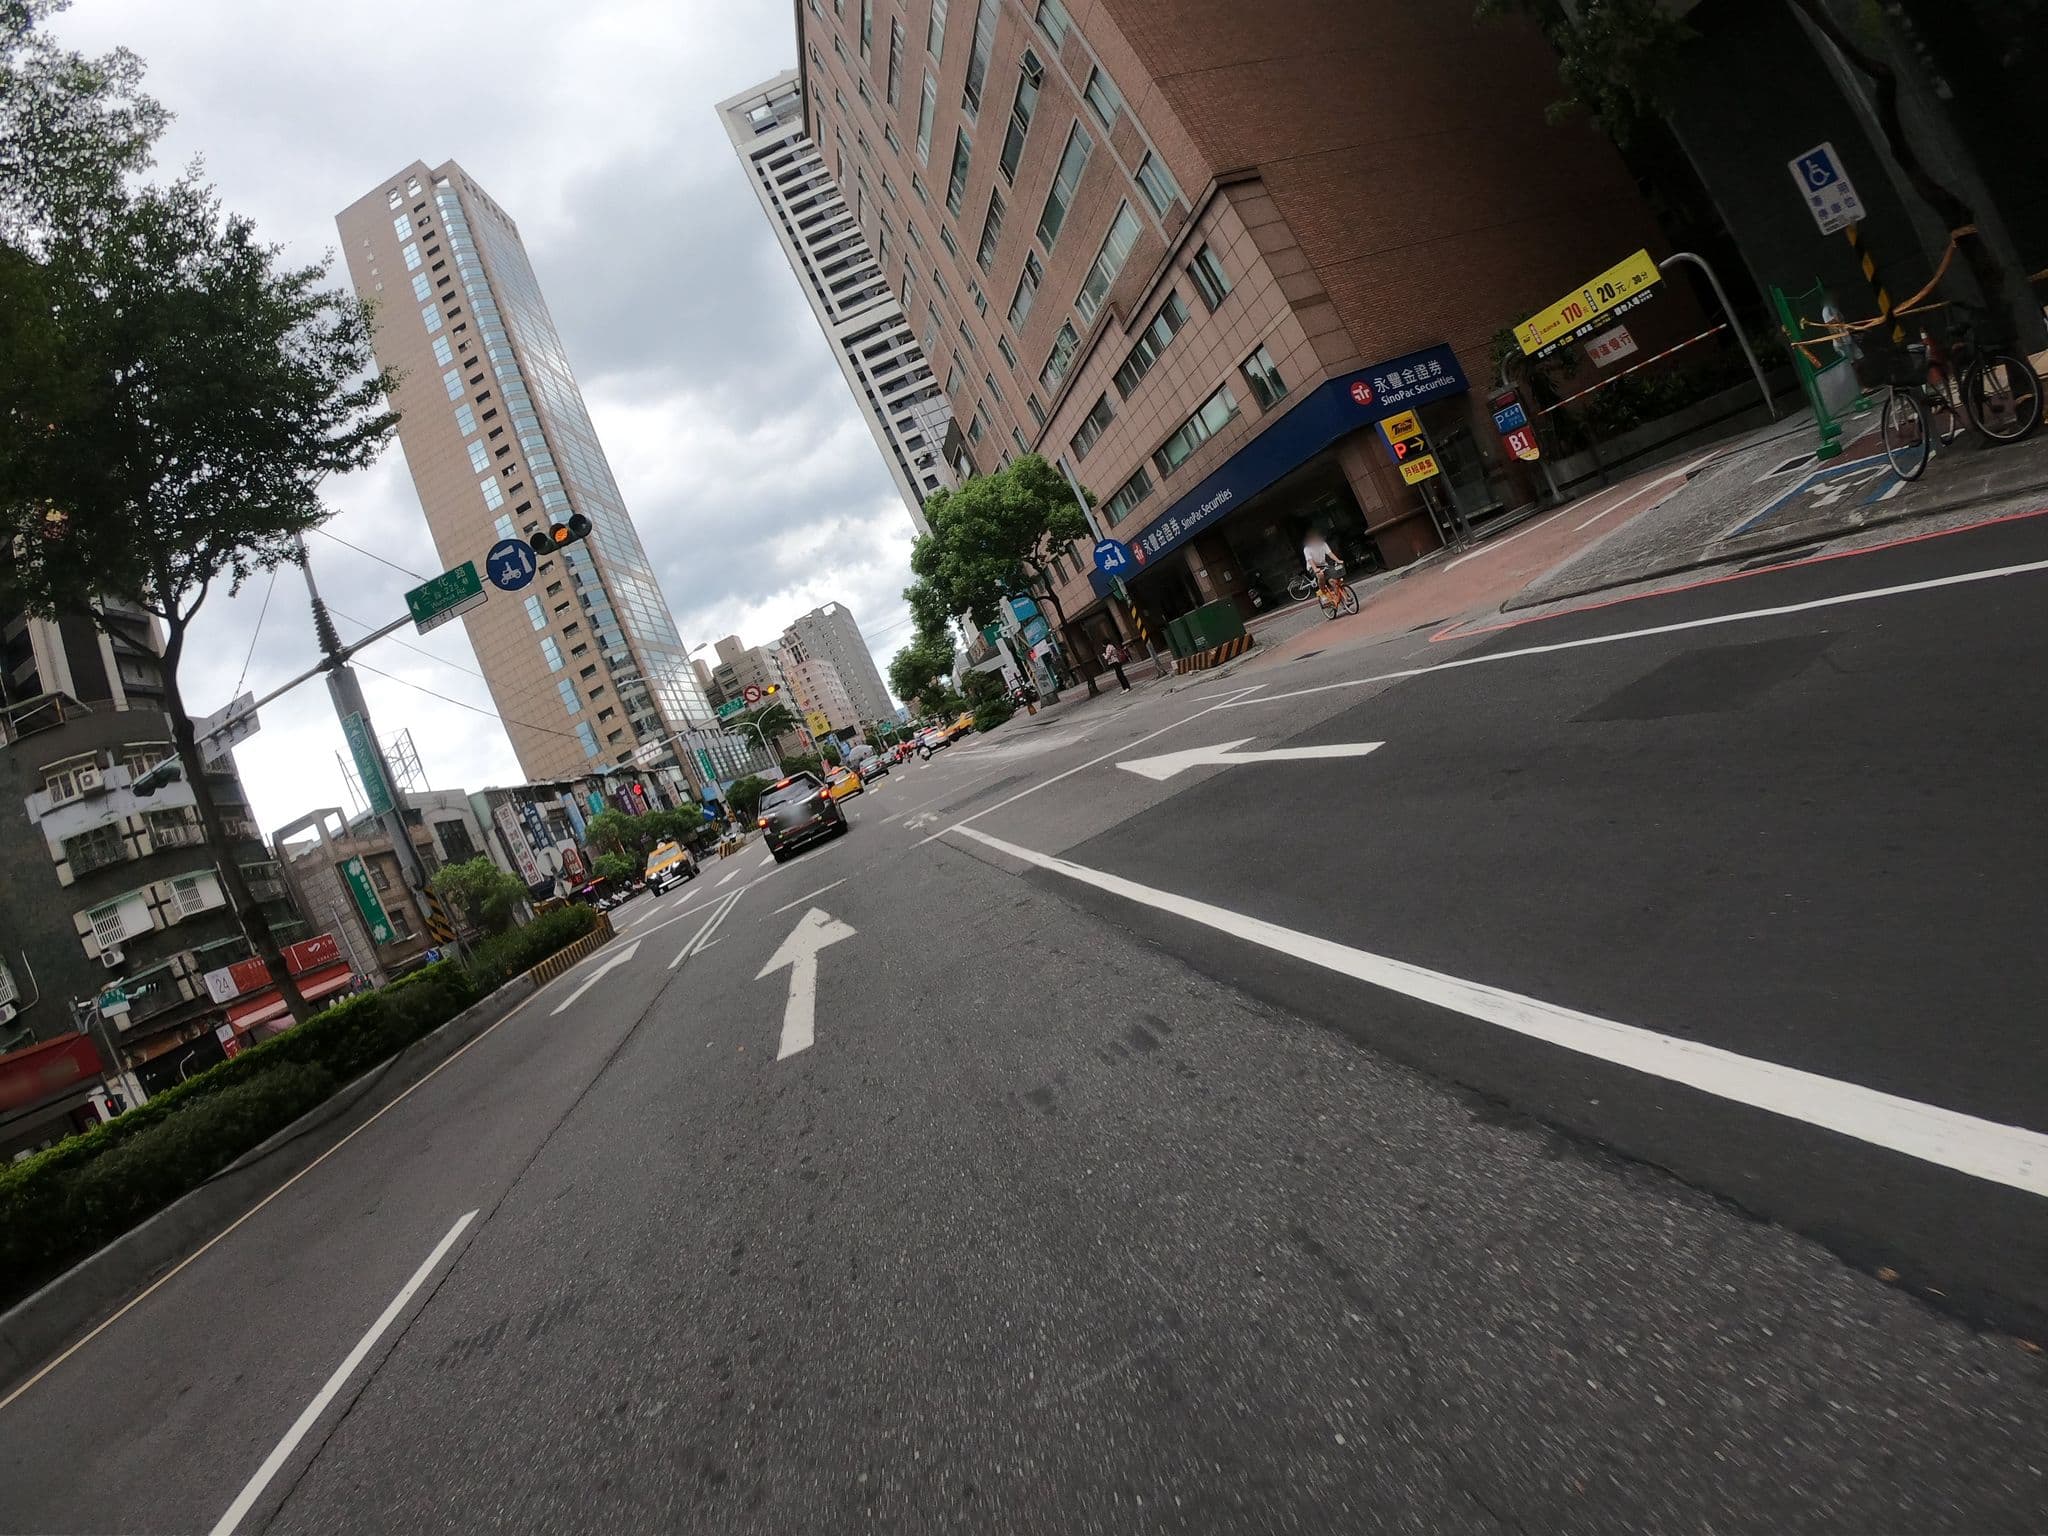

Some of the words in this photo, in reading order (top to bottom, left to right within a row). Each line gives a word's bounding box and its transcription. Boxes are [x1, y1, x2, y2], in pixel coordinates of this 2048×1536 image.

[1374, 360, 1442, 393] 永豐金證券
[1380, 388, 1416, 406] SinoPac
[1414, 375, 1456, 394] Securities
[1508, 431, 1529, 451] B1
[1181, 509, 1204, 530] SinoPac
[1201, 488, 1233, 516] Securities
[1142, 517, 1180, 555] 永豐金證券
